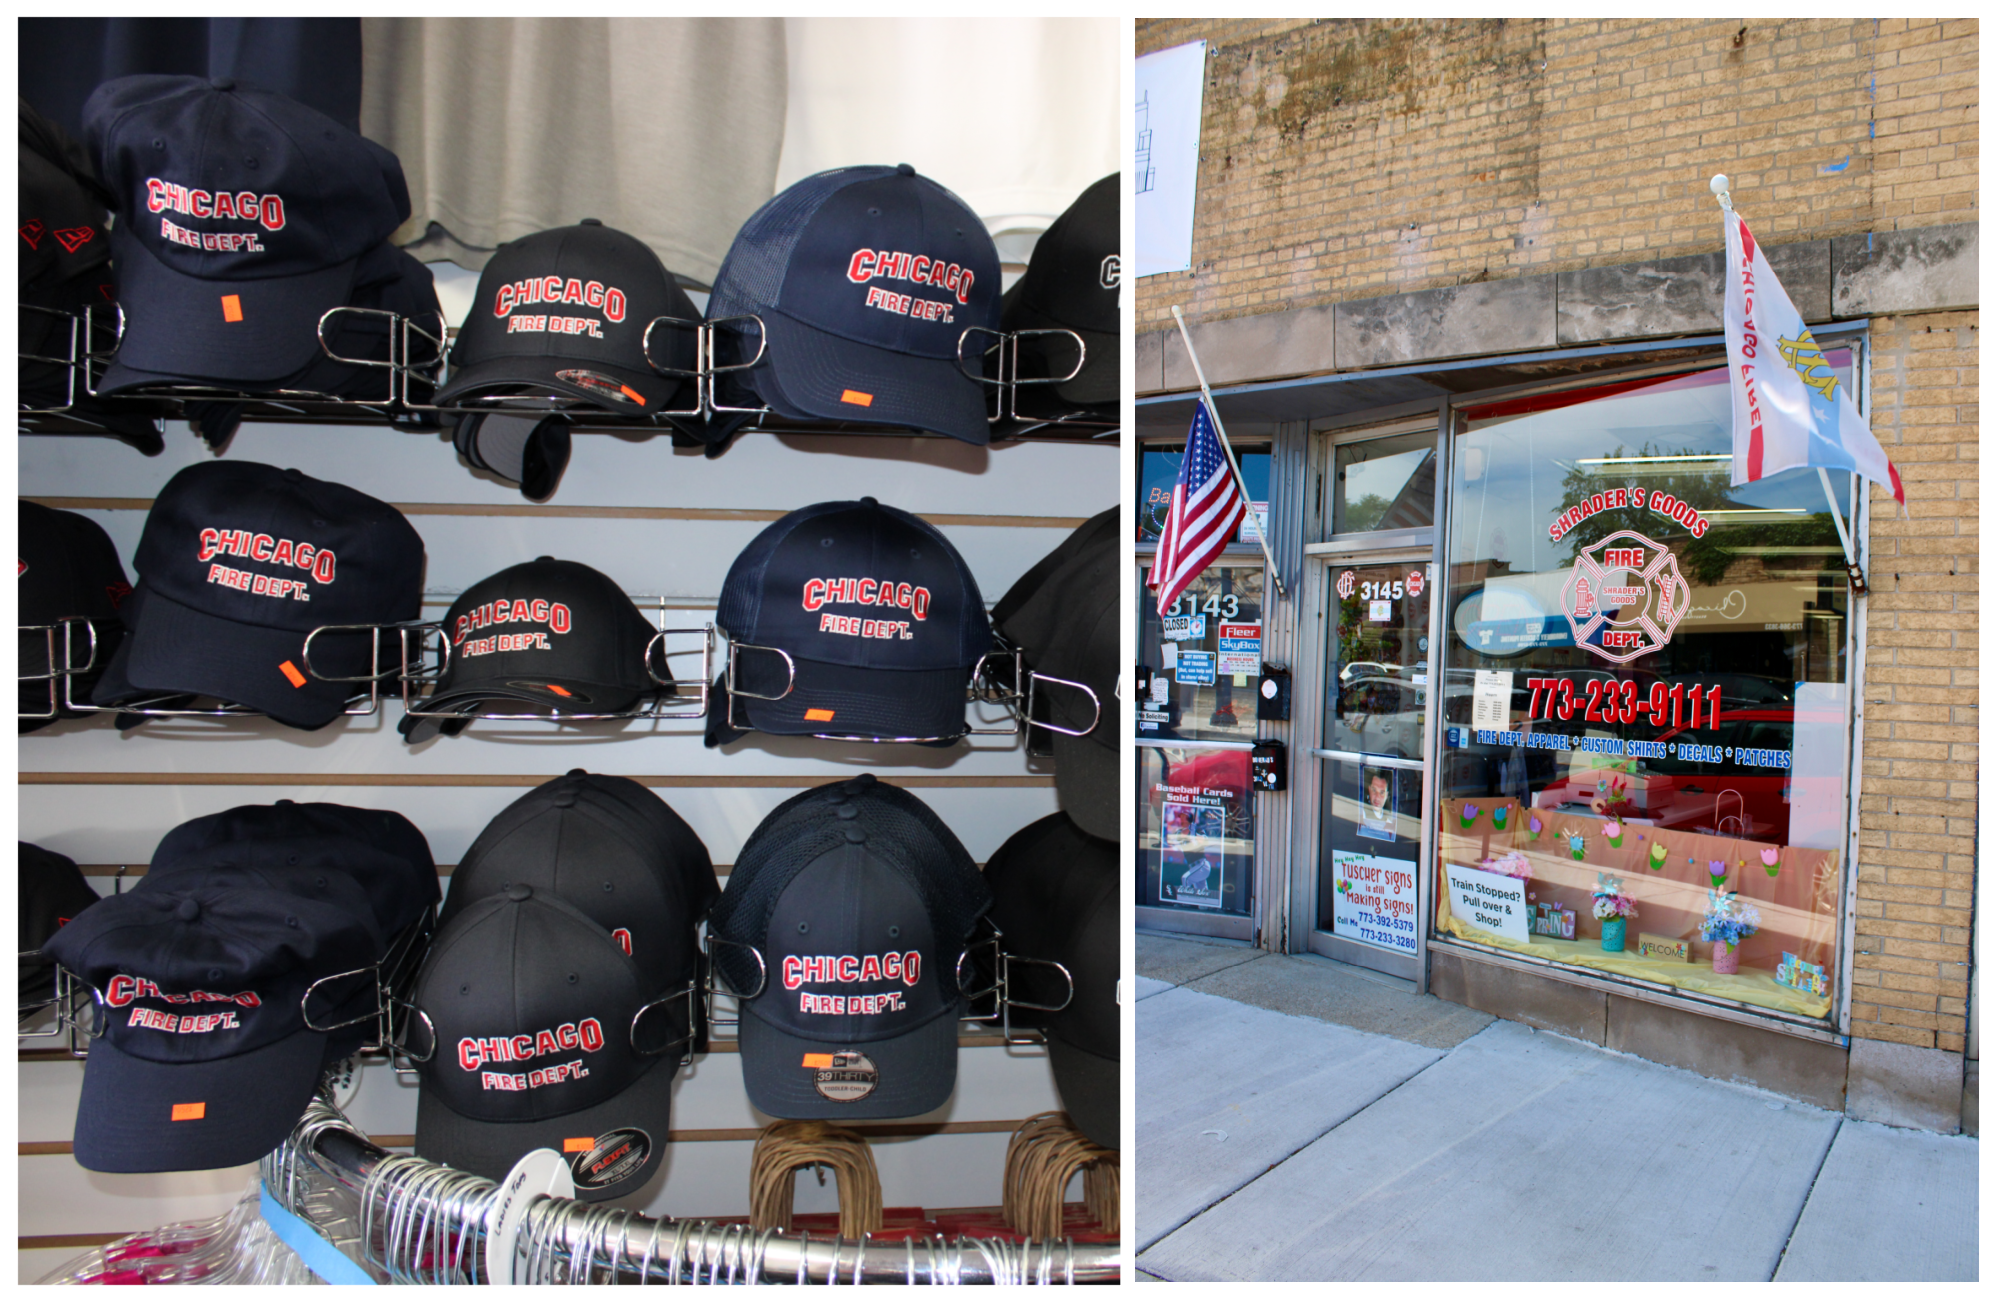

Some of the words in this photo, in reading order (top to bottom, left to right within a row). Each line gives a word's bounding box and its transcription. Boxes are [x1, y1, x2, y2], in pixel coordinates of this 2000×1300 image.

[146, 178, 286, 231] CHICAGO
[161, 217, 201, 249] FIRE
[202, 233, 265, 252] DEPT.
[846, 248, 974, 305] CHICAGO
[493, 275, 627, 323] CHICAGO
[865, 286, 911, 315] FIRE
[910, 298, 954, 323] DEPT.
[507, 315, 547, 333] FIRE
[548, 315, 604, 339] DEPT.
[1549, 487, 1646, 541] SHRADER'S
[1649, 490, 1709, 539] GOODS
[197, 527, 336, 584] CHICAGO
[1604, 548, 1644, 567] FIRE
[207, 563, 251, 592] FIRE
[252, 574, 310, 601] DEPT.
[1360, 581, 1403, 600] 3145
[1603, 586, 1645, 596] SHRADER'S
[802, 577, 931, 621] CHICAGO
[1166, 594, 1239, 618] 3143
[1610, 596, 1636, 605] GOODS
[453, 598, 572, 647] CHICAGO
[819, 613, 860, 636] FIRE
[863, 619, 913, 639] DEPT.
[1164, 618, 1188, 631] CLOSED
[1226, 627, 1256, 639] Fleer
[462, 635, 496, 658] FIRE
[498, 632, 551, 651] DEPT.
[1221, 639, 1260, 650] SkyBox
[1602, 631, 1645, 648] DEPT.
[1146, 712, 1168, 720] Soliciting
[1527, 677, 1721, 731] 773-233-9111
[1477, 729, 1497, 745] FIRE
[1498, 730, 1524, 747] DEPT.
[1526, 733, 1571, 751] APPAREL
[1581, 736, 1624, 755] CUSTOM
[1627, 740, 1667, 759] SHIRTS
[1677, 744, 1723, 764] DECALS
[1734, 747, 1791, 769] PATCHES
[1155, 783, 1200, 795] Baseball
[1203, 787, 1233, 798] Cards
[1166, 793, 1189, 803] Sold
[1192, 795, 1221, 806] Here!
[1366, 884, 1371, 892] is
[1373, 884, 1385, 894] still
[1451, 877, 1474, 892] Train
[1476, 883, 1521, 903] Stopped?
[1346, 892, 1382, 914] Making
[1463, 894, 1480, 908] Pull
[1482, 899, 1503, 913] over
[1505, 904, 1512, 915] &
[1350, 918, 1358, 927] Me
[1358, 911, 1414, 932] 773-392-5379
[1475, 912, 1503, 928] Shop!
[1360, 927, 1416, 949] 773-233-3280
[1640, 941, 1685, 959] WELCOME
[782, 950, 921, 990] CHICAGO
[105, 974, 262, 1008] CHCAGO
[800, 991, 845, 1015] FIRE
[847, 991, 906, 1015] DEPT.
[127, 1007, 180, 1033] FIRE
[178, 1011, 241, 1033] DEPT.
[457, 1017, 605, 1071] CHICAGO
[481, 1071, 528, 1091] FIRE
[528, 1059, 590, 1089] DEPT.
[817, 1071, 876, 1082] 39THIRTY
[591, 1142, 631, 1175] FLEXFIT
